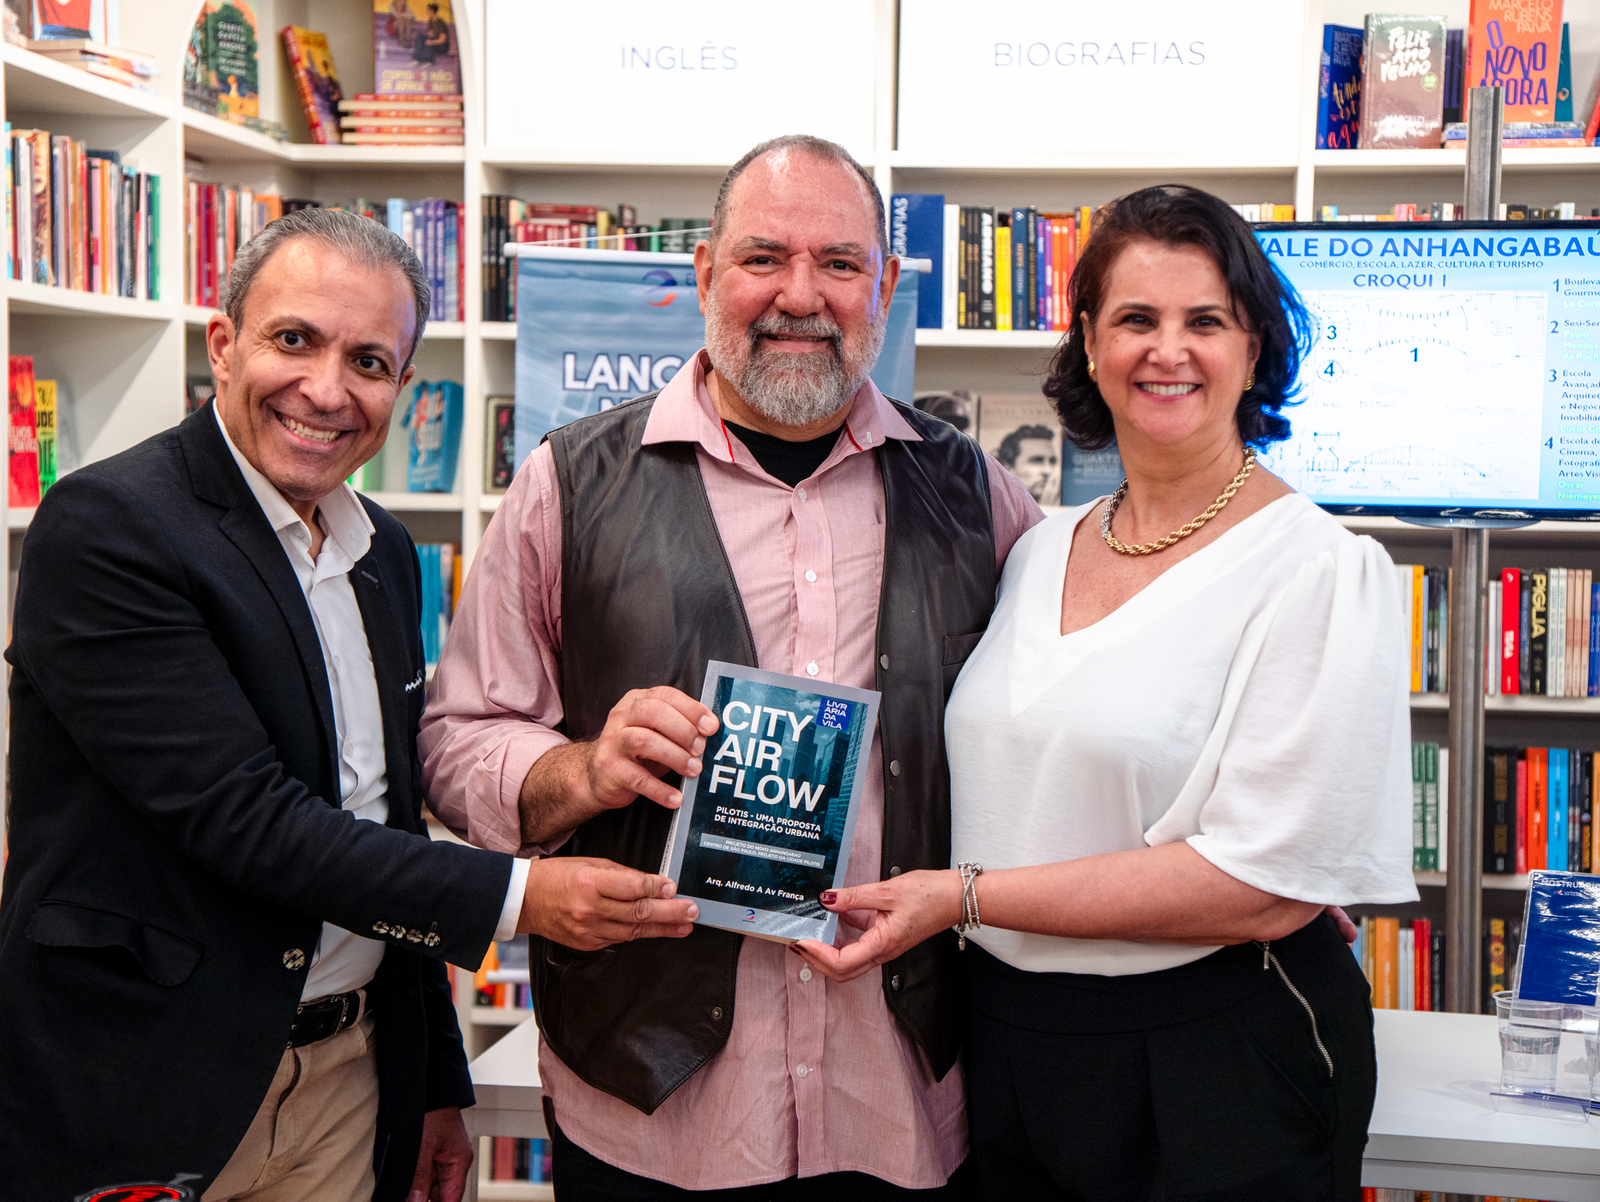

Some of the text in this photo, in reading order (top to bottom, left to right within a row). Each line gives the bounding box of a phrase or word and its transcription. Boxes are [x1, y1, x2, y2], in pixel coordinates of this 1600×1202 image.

[1504, 9, 1553, 22] RUBENS
[1486, 20, 1504, 50] O
[1516, 22, 1552, 34] PAIVA
[621, 41, 738, 70] INGLÊS
[994, 41, 1206, 66] BIOGRAFIAS
[1392, 47, 1431, 65] ANO
[1485, 42, 1547, 80] NOVO
[1380, 60, 1432, 83] VELHO
[981, 212, 993, 295] ADRIANO
[1329, 238, 1373, 257] DO
[1300, 260, 1355, 269] COMÉRCIO,
[1357, 261, 1399, 269] ESCOLA,
[1401, 261, 1435, 269] LAZER,
[1497, 260, 1544, 268] TURISMO
[1353, 274, 1433, 290] CROQUI
[1552, 278, 1560, 293] 1
[1326, 325, 1337, 340] 3
[1550, 320, 1559, 334] 2
[1410, 347, 1418, 362] 1
[1323, 362, 1335, 377] 4
[1548, 369, 1591, 383] 3 Escola
[1544, 436, 1553, 449] 4
[1560, 437, 1588, 445] Escola
[1557, 480, 1585, 489] Oscar
[1532, 574, 1547, 639] PIGLIA
[824, 706, 847, 718] ARIA
[826, 700, 848, 710] LIVR
[722, 701, 814, 742] CITY
[822, 719, 843, 730] VILA
[823, 712, 837, 722] DA
[713, 733, 783, 772] AIR
[708, 764, 826, 812] FLOW
[714, 814, 820, 840] DE INTEGRAÇÃO URBANA
[716, 806, 749, 818] PILOTIS
[756, 813, 775, 823] UMA
[777, 817, 821, 832] PROPOSTA
[703, 841, 723, 849] CENTRO
[757, 851, 779, 860] PROJETO
[725, 840, 746, 848] PROJETO
[706, 877, 804, 902] Arq. Alfredo A Av França
